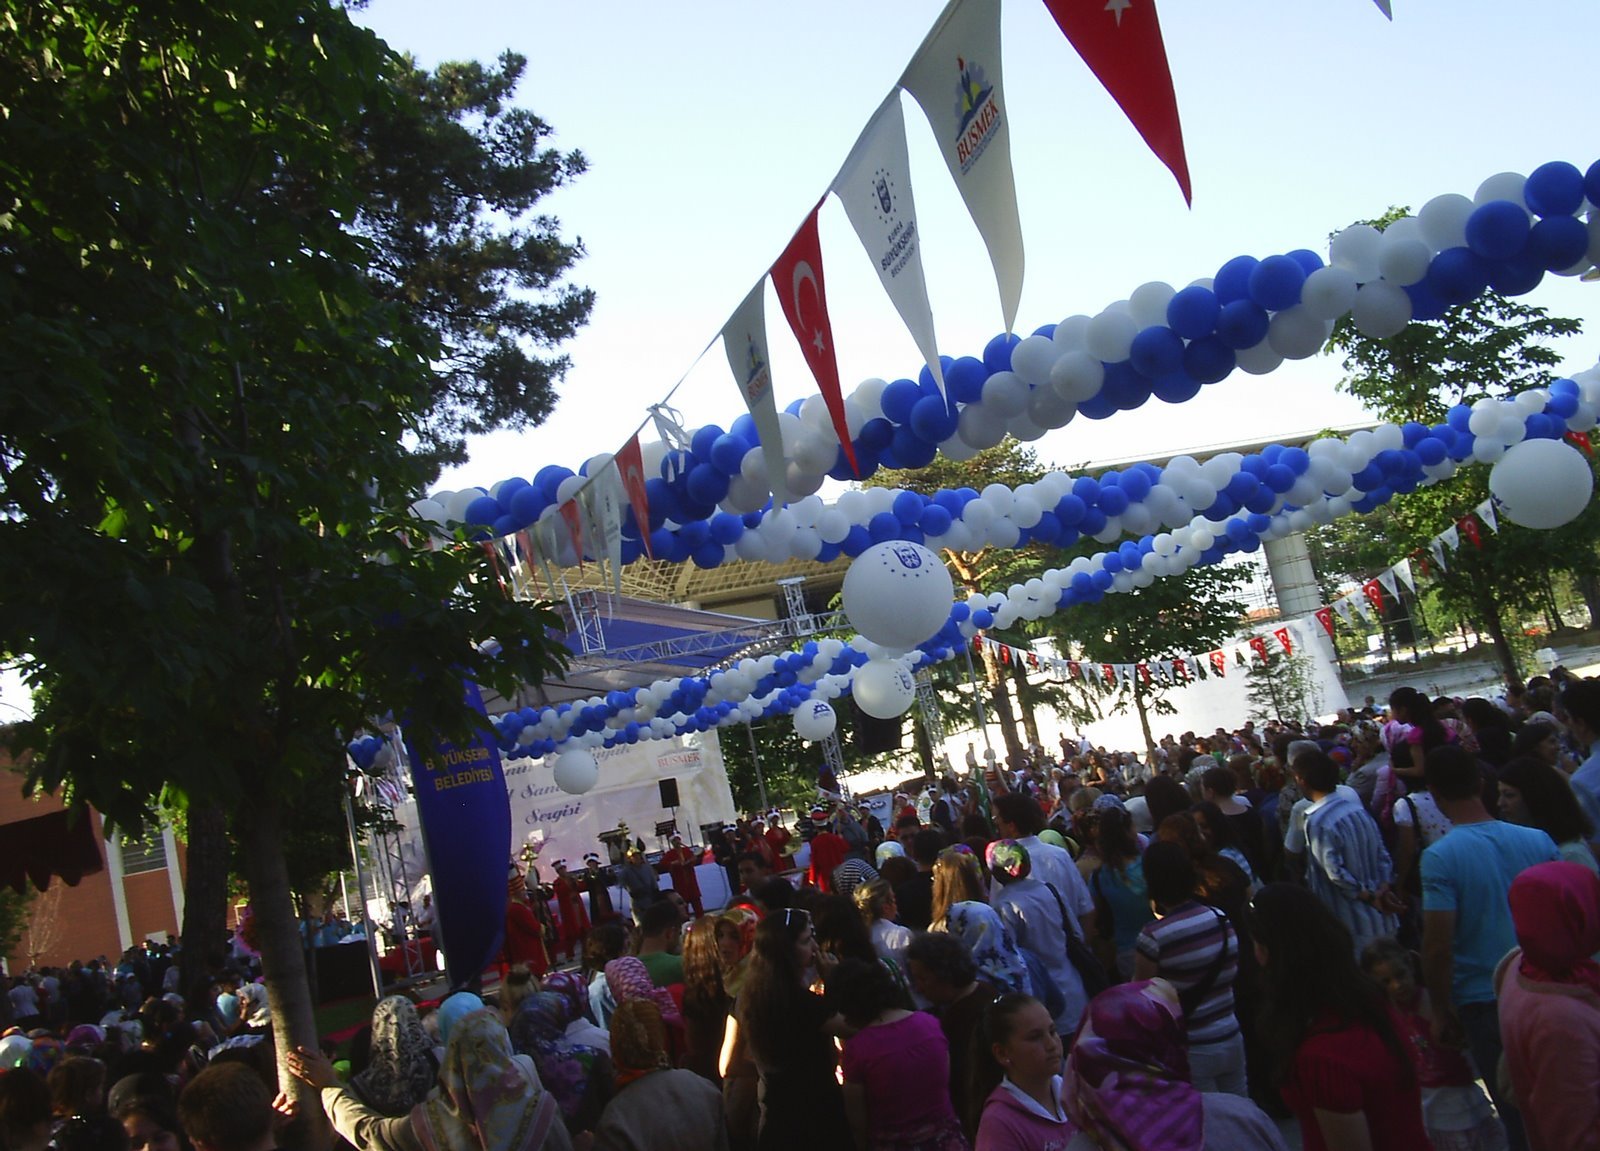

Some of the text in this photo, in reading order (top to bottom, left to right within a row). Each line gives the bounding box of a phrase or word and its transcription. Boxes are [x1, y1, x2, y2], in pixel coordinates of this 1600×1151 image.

[956, 94, 999, 165] BUSMEK
[425, 747, 491, 771] BYÜKŞER
[525, 802, 581, 825] Sergisi
